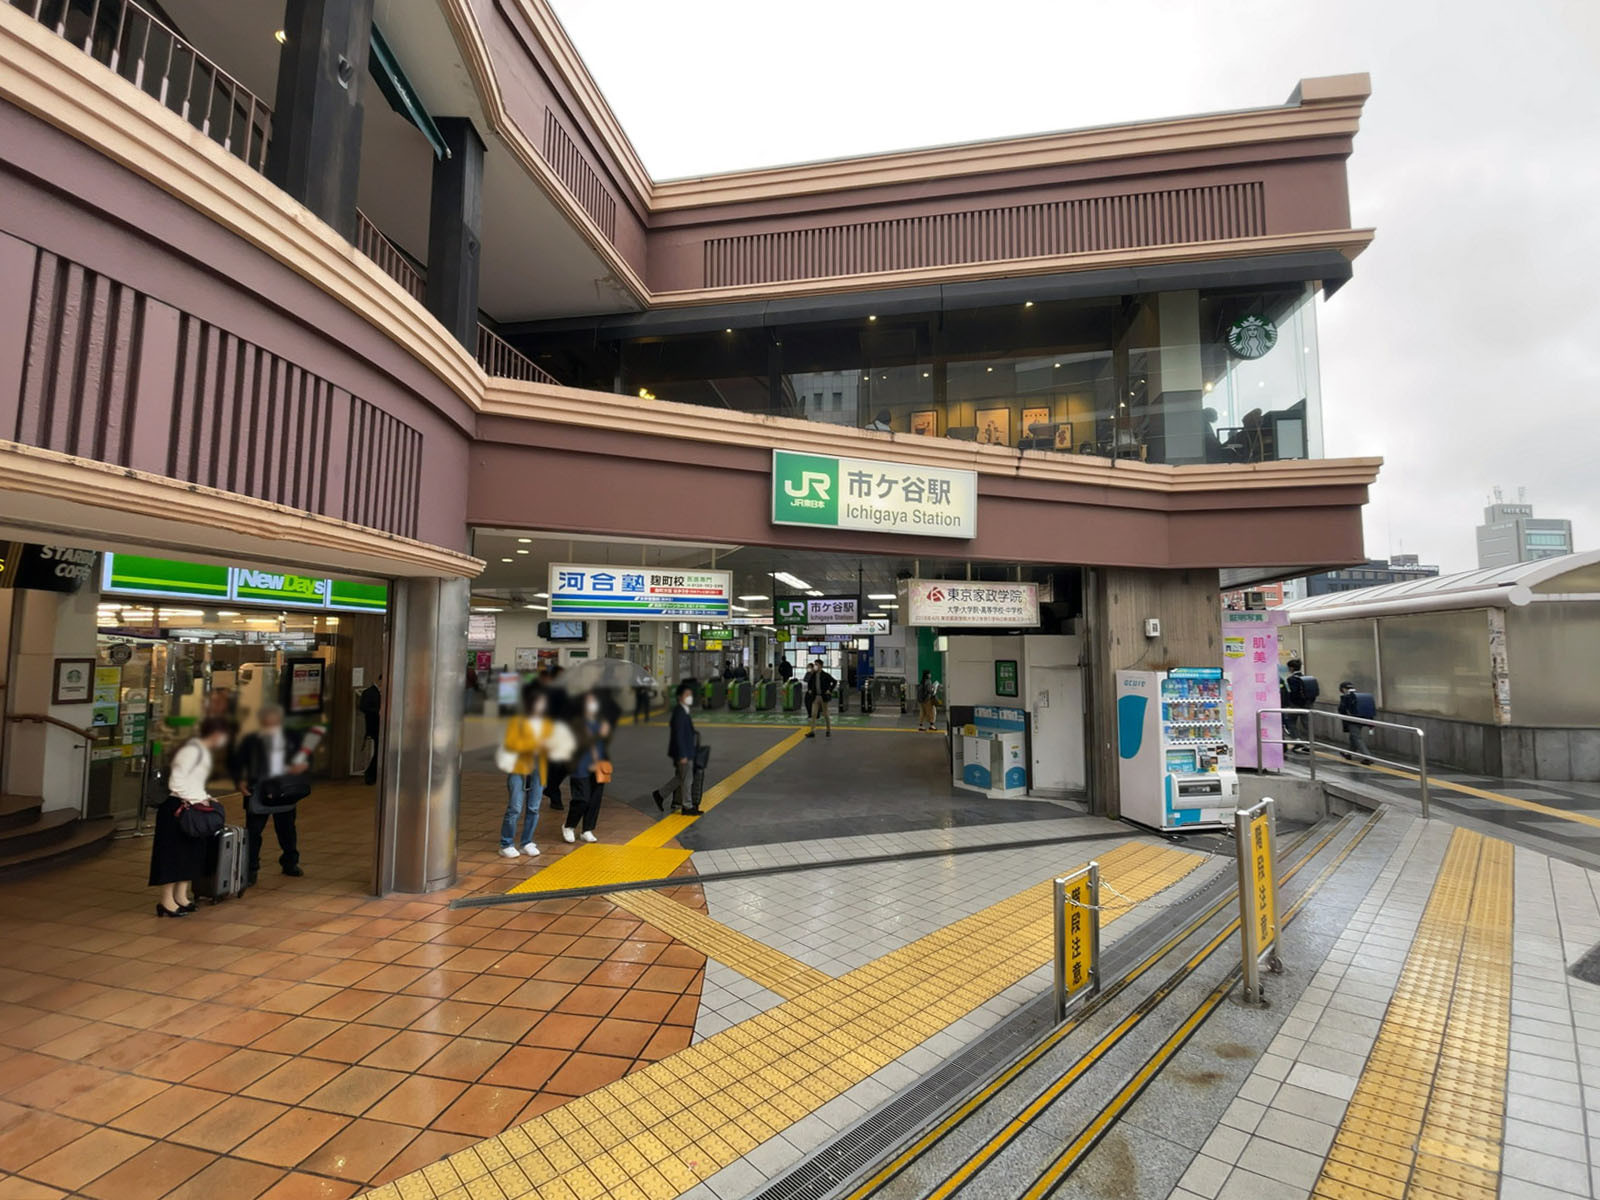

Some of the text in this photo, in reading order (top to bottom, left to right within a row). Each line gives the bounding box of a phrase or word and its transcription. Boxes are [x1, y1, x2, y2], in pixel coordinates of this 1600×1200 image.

[784, 471, 831, 500] JR
[848, 470, 951, 505] 市ケ谷駅
[790, 498, 826, 509] JR東日本
[846, 503, 961, 527] Ichigaya Station
[239, 568, 325, 595] NewDays
[558, 571, 645, 592] 河合塾
[947, 588, 1023, 603] 東京家政学院
[780, 602, 805, 617] JR
